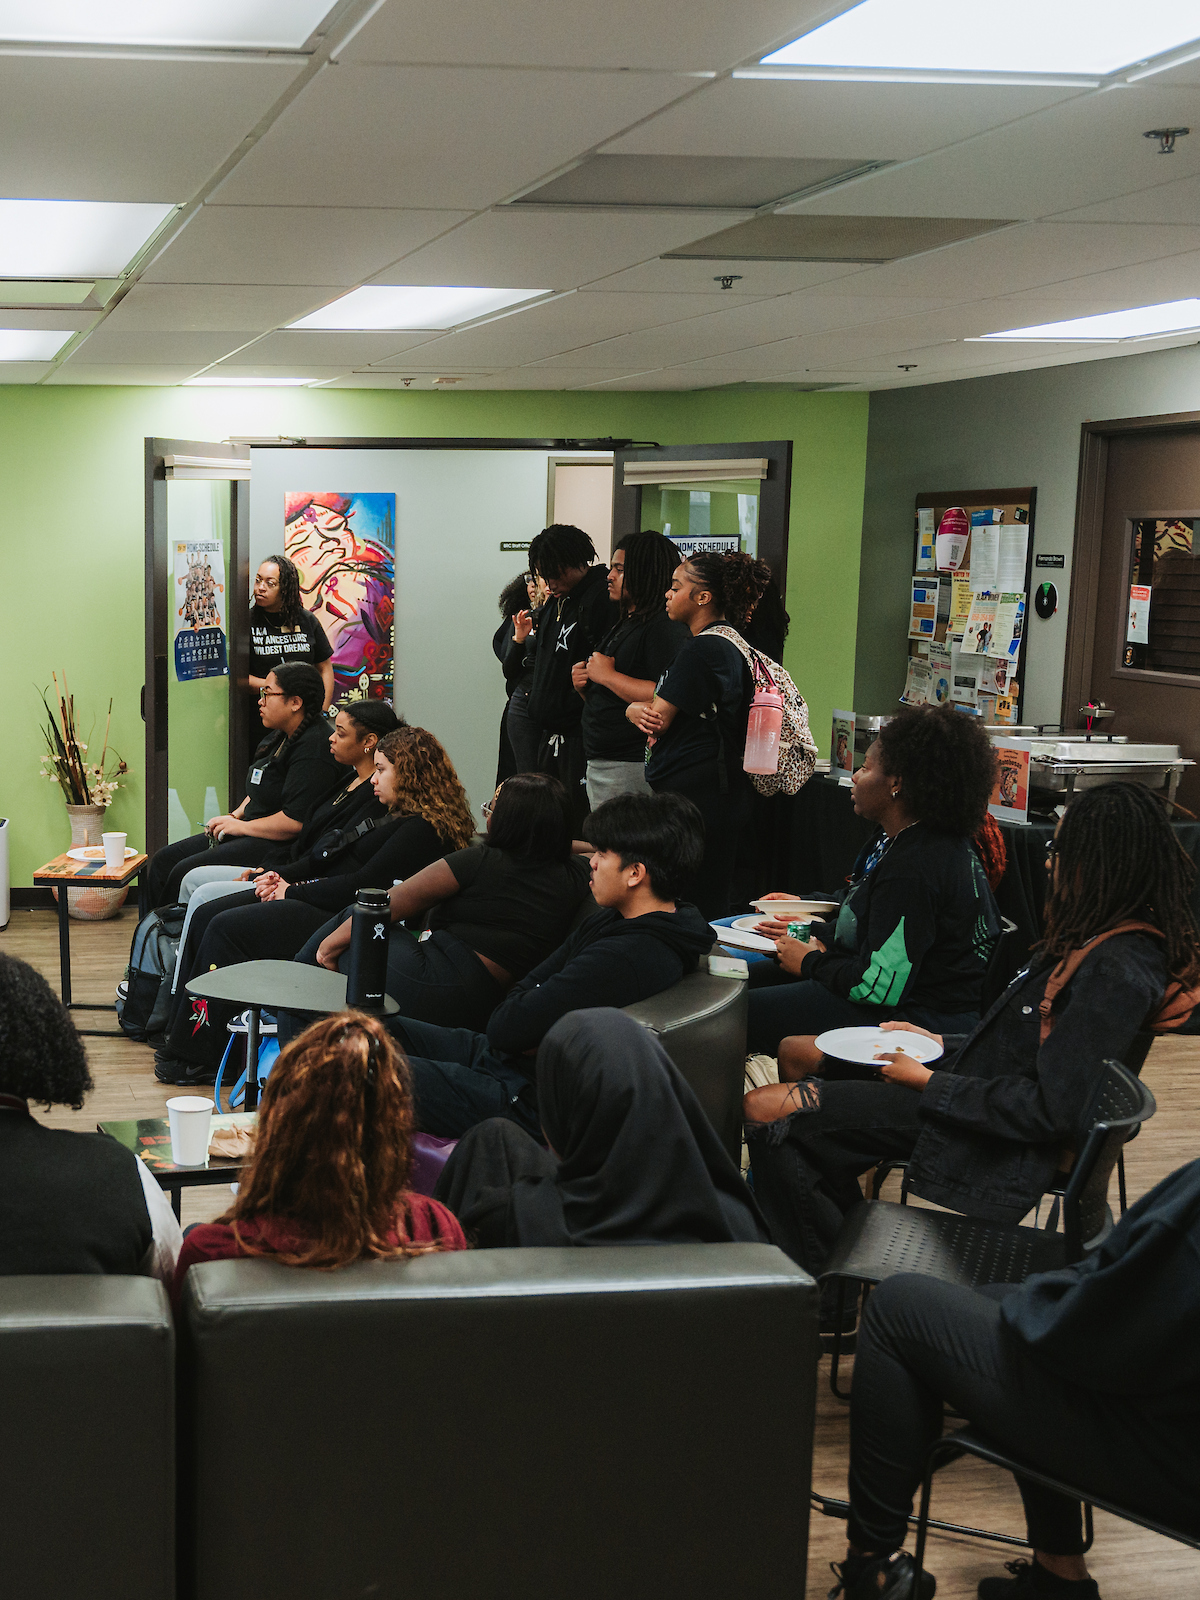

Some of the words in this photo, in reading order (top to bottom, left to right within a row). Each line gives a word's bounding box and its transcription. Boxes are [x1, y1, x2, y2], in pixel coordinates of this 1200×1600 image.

[199, 542, 220, 552] SCHEDULE
[698, 541, 735, 552] SCHEDULE
[252, 636, 264, 645] MY
[283, 643, 311, 653] DREAMS
